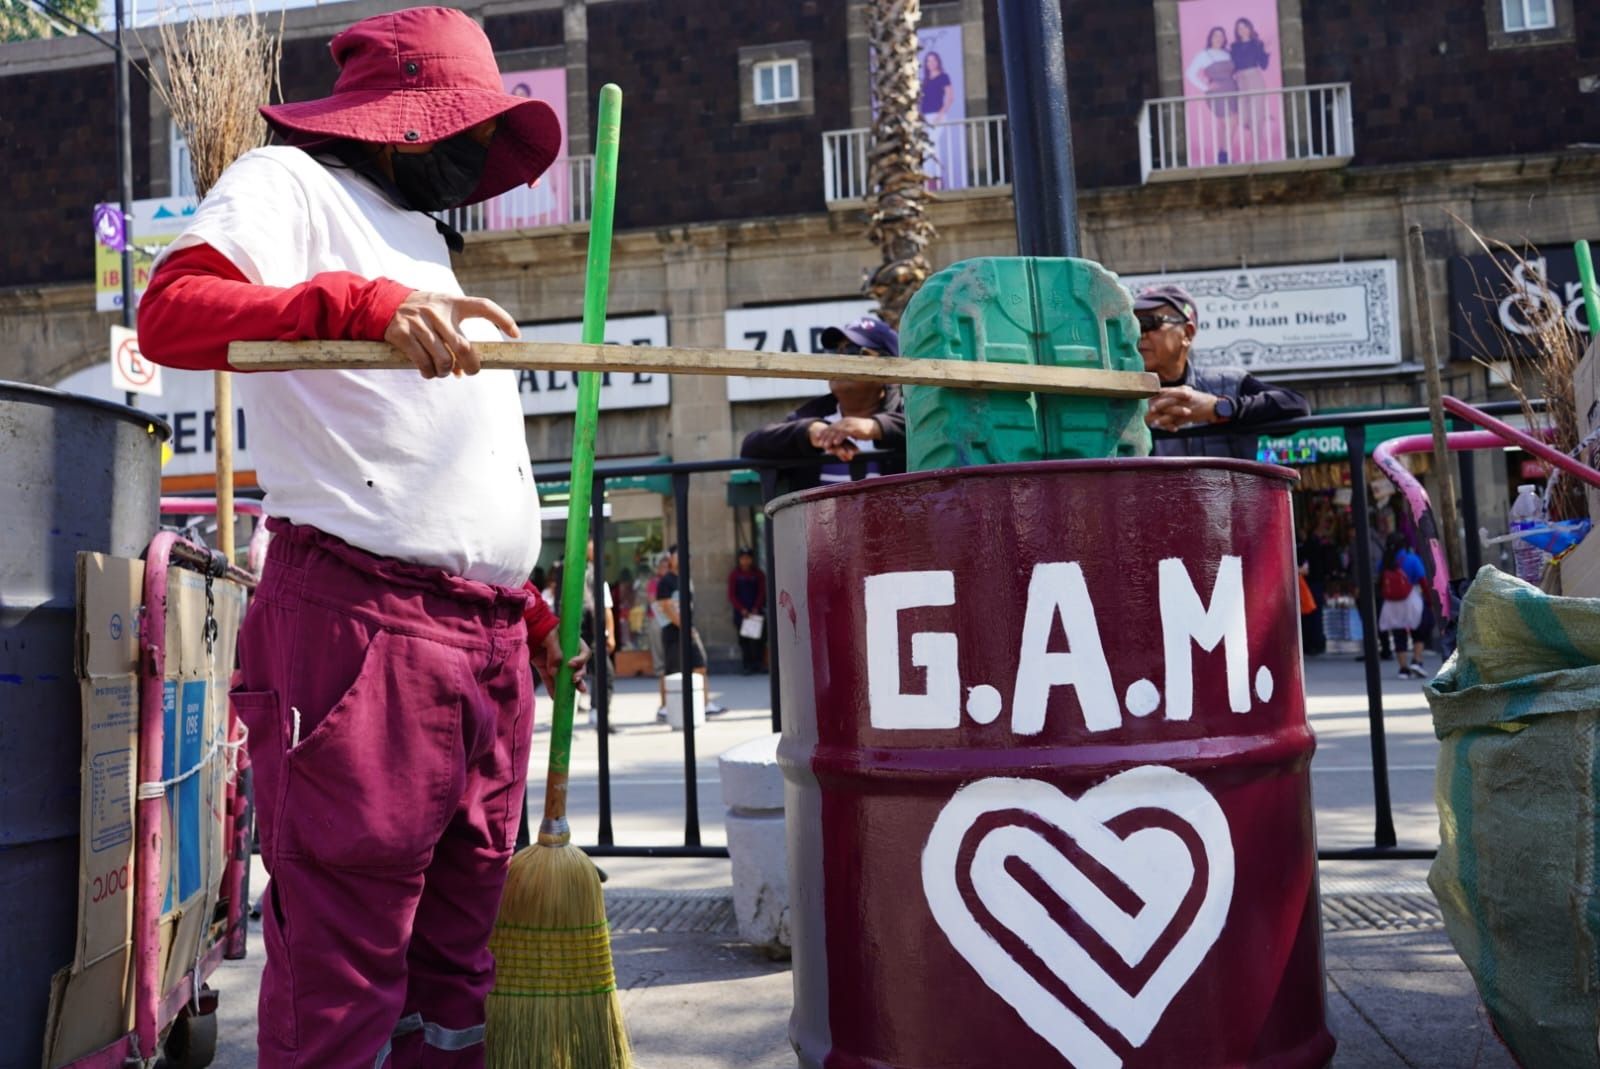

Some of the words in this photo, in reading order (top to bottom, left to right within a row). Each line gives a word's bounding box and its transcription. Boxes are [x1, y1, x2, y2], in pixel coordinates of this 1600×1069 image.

[1217, 316, 1240, 330] De
[1246, 314, 1288, 328] Juan
[1295, 310, 1347, 326] Diego
[864, 555, 1274, 736] G.A.M.
